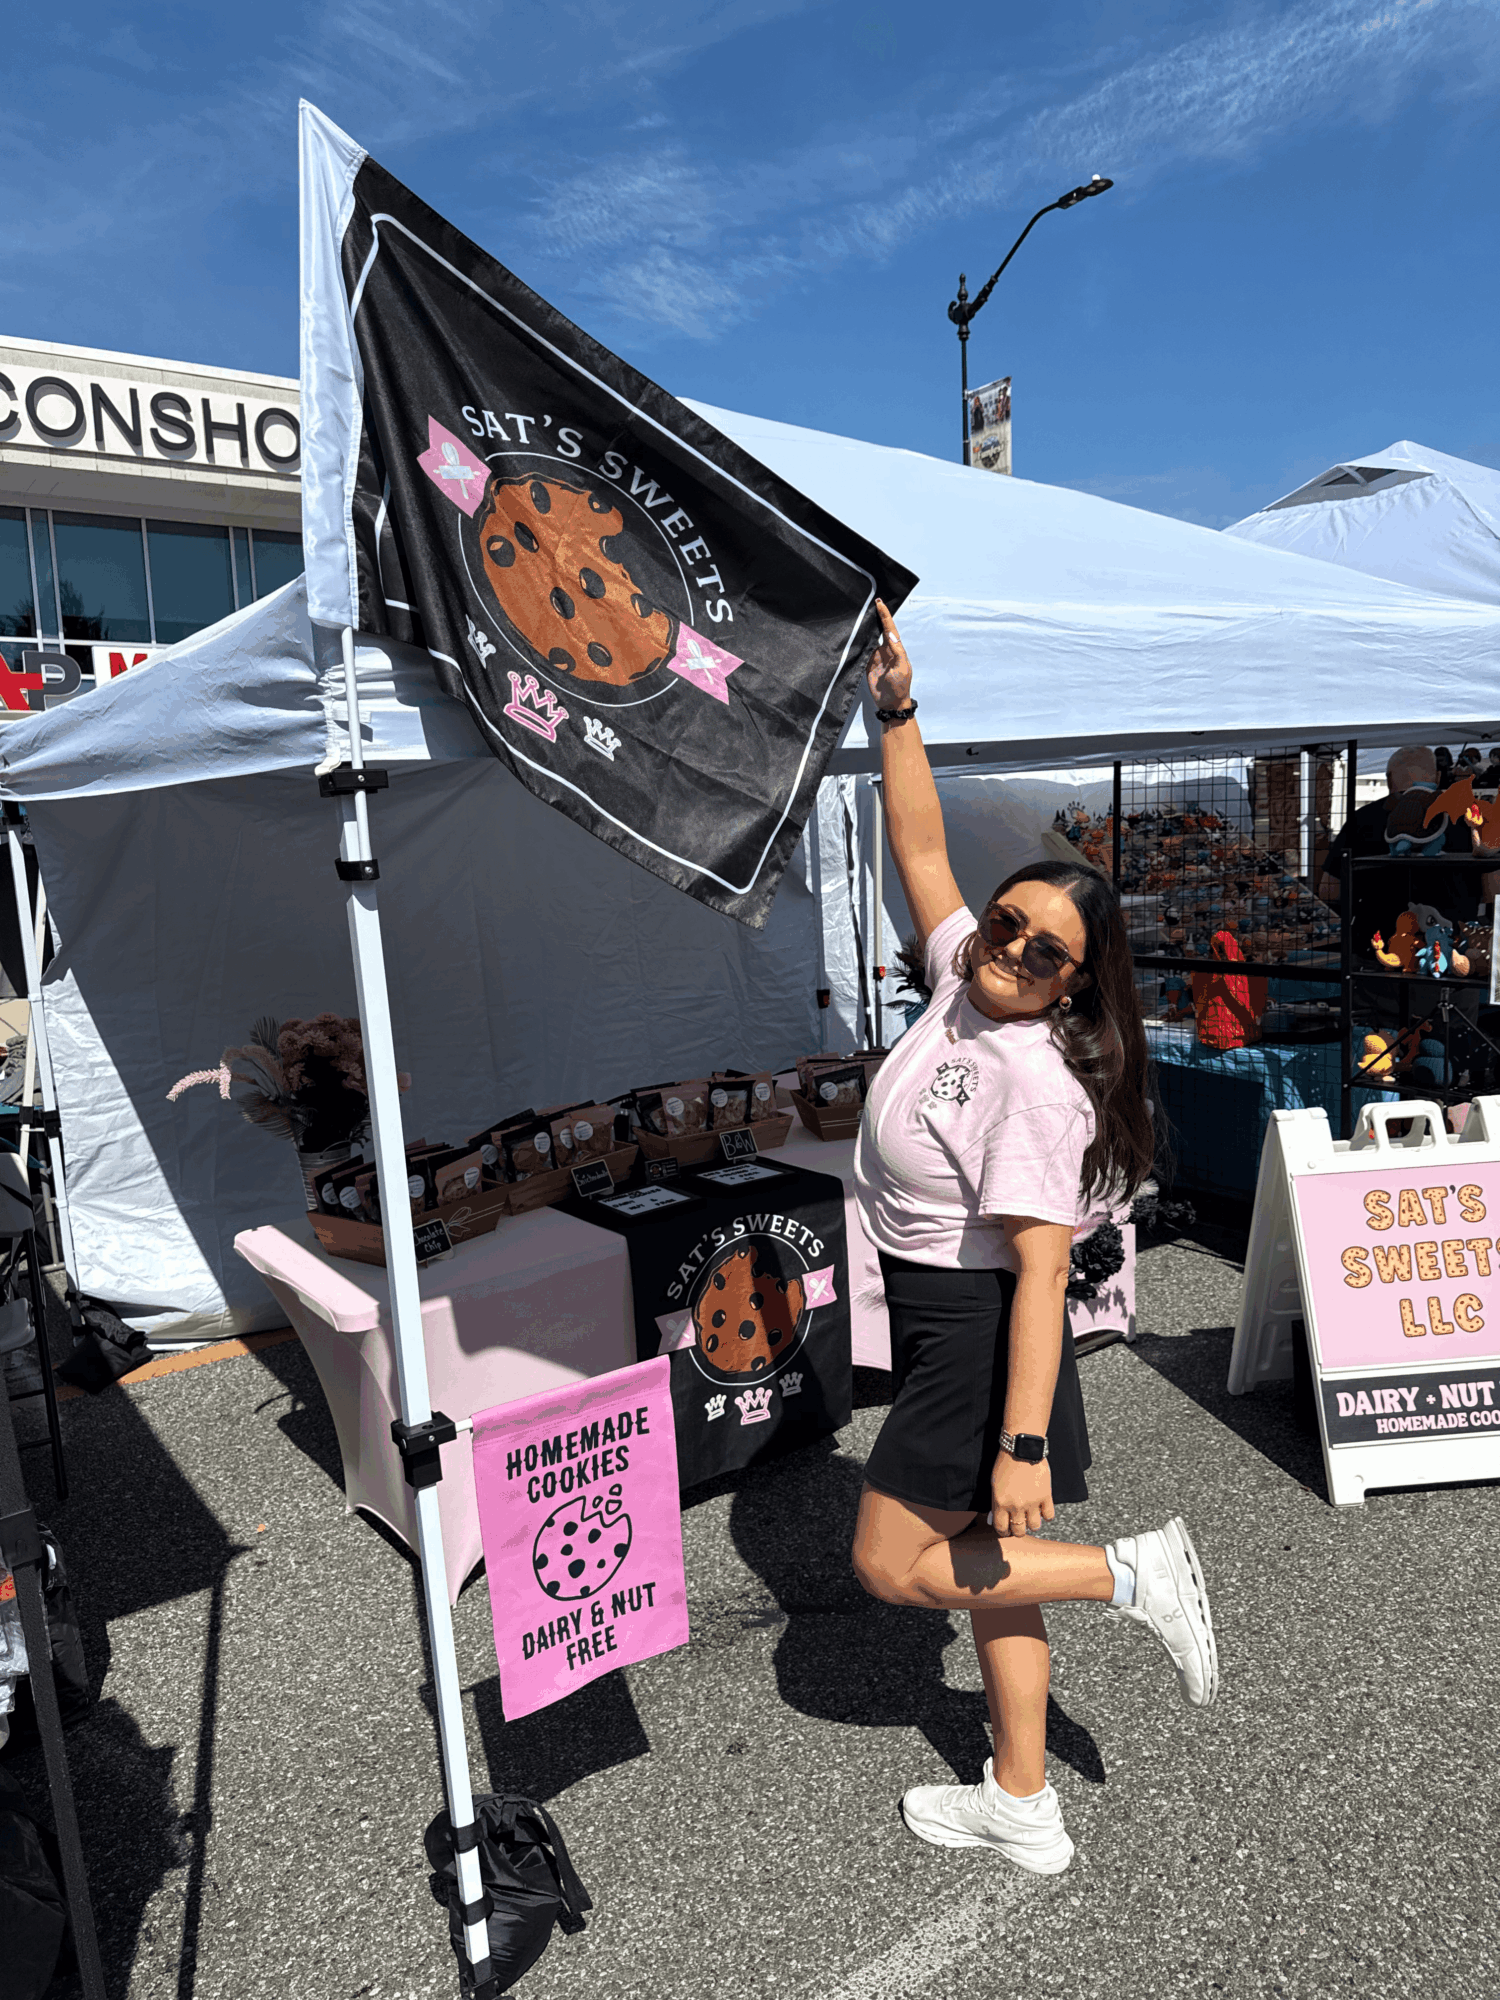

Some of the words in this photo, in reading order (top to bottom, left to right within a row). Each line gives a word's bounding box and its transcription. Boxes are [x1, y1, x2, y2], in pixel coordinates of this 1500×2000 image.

[461, 405, 584, 459] SAT'S
[598, 450, 735, 624] SWEETS
[721, 1131, 755, 1156] B&W
[1363, 1184, 1487, 1231] SAT'S
[667, 1227, 726, 1299] SAT'S
[732, 1213, 825, 1258] SWEETS
[1341, 1237, 1500, 1289] SWEET
[1398, 1293, 1485, 1337] LLC
[1336, 1386, 1420, 1418] DAIRY
[1438, 1381, 1495, 1409] NUT
[1376, 1411, 1469, 1434] HOMEMADE
[505, 1406, 650, 1481] HOMEMADE
[527, 1445, 630, 1504] COOKIES
[521, 1607, 583, 1660] DAIRY
[590, 1600, 605, 1628] &
[611, 1582, 657, 1618] NUT
[566, 1625, 618, 1671] FREE
